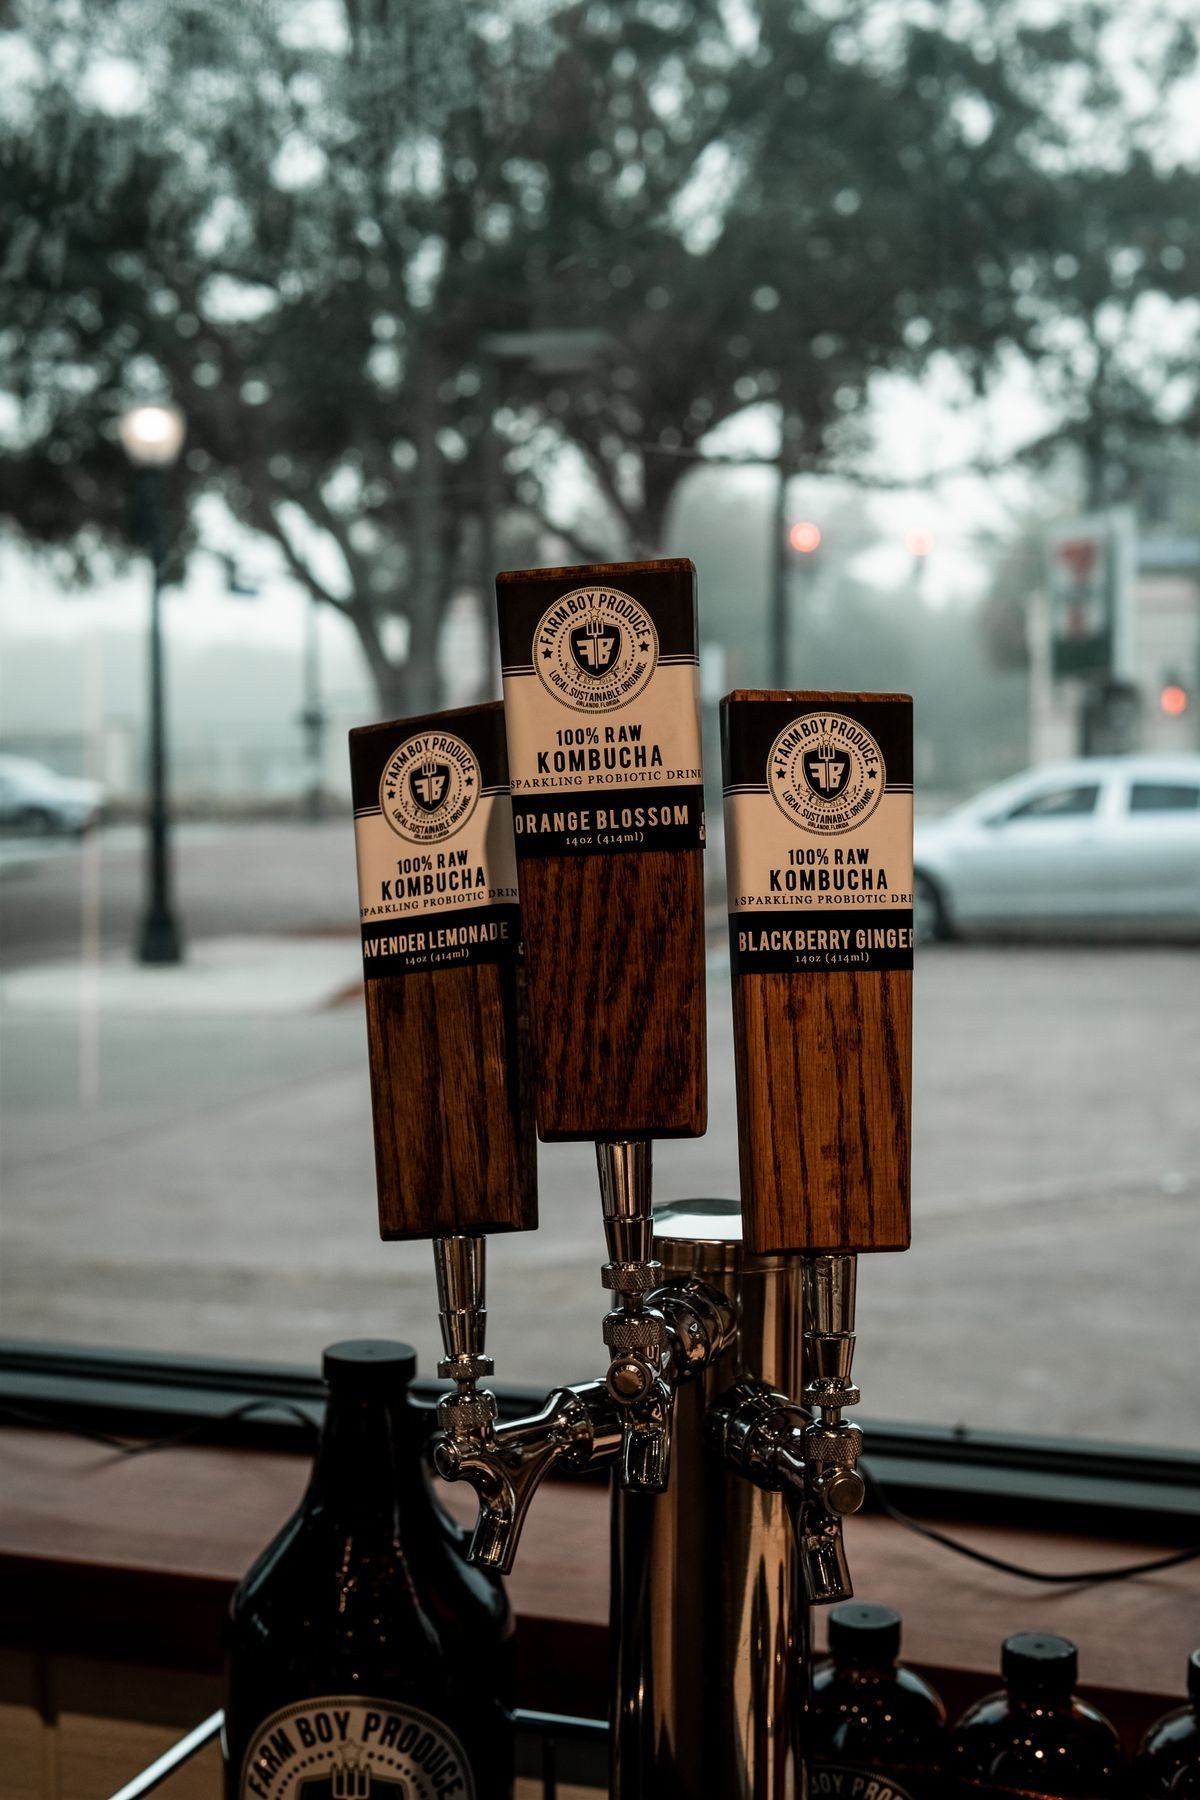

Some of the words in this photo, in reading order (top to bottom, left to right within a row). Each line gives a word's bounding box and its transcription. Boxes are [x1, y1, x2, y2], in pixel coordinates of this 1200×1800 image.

[540, 607, 572, 646] FARM
[568, 593, 595, 614] BOY
[599, 593, 651, 639] PRODUCE
[556, 727, 599, 747] 100%
[605, 724, 642, 743] RAW
[773, 728, 804, 766] FARM
[801, 719, 828, 737] BOY
[830, 719, 879, 766] PRODUCE
[385, 751, 409, 787] FARM
[408, 737, 430, 758] BOY
[432, 736, 475, 775] PRODUCE
[537, 745, 663, 774] KOMBUCHA
[510, 775, 583, 789] SPARKLING
[588, 771, 662, 785] PROBIOTIC
[515, 811, 591, 835] ORANGE
[596, 804, 689, 830] BLOSSOM
[565, 835, 593, 847] 14oz
[597, 832, 645, 846] (414ml)
[397, 855, 433, 875] 100%
[437, 850, 469, 870] RAW
[788, 848, 829, 866] 100%
[834, 848, 870, 865] RAW
[381, 867, 486, 901] KOMBUCHA
[769, 868, 888, 891] KOMBUCHA
[423, 891, 484, 908] PROBIOTIC
[488, 888, 519, 899] DRIN
[740, 895, 813, 906] SPARKLING
[818, 893, 887, 904] PROBIOTIC
[891, 893, 913, 903] DRI
[429, 921, 509, 949] LEMONADE
[738, 929, 855, 952] BLACKBERRY
[405, 956, 427, 965] 14oz
[430, 948, 470, 962] (414ml)
[795, 955, 821, 964] 14oz
[825, 952, 870, 964] (414ml)
[248, 1728, 297, 1800] FARM
[295, 1711, 350, 1748] BOY
[361, 1711, 464, 1800] PRODUCE
